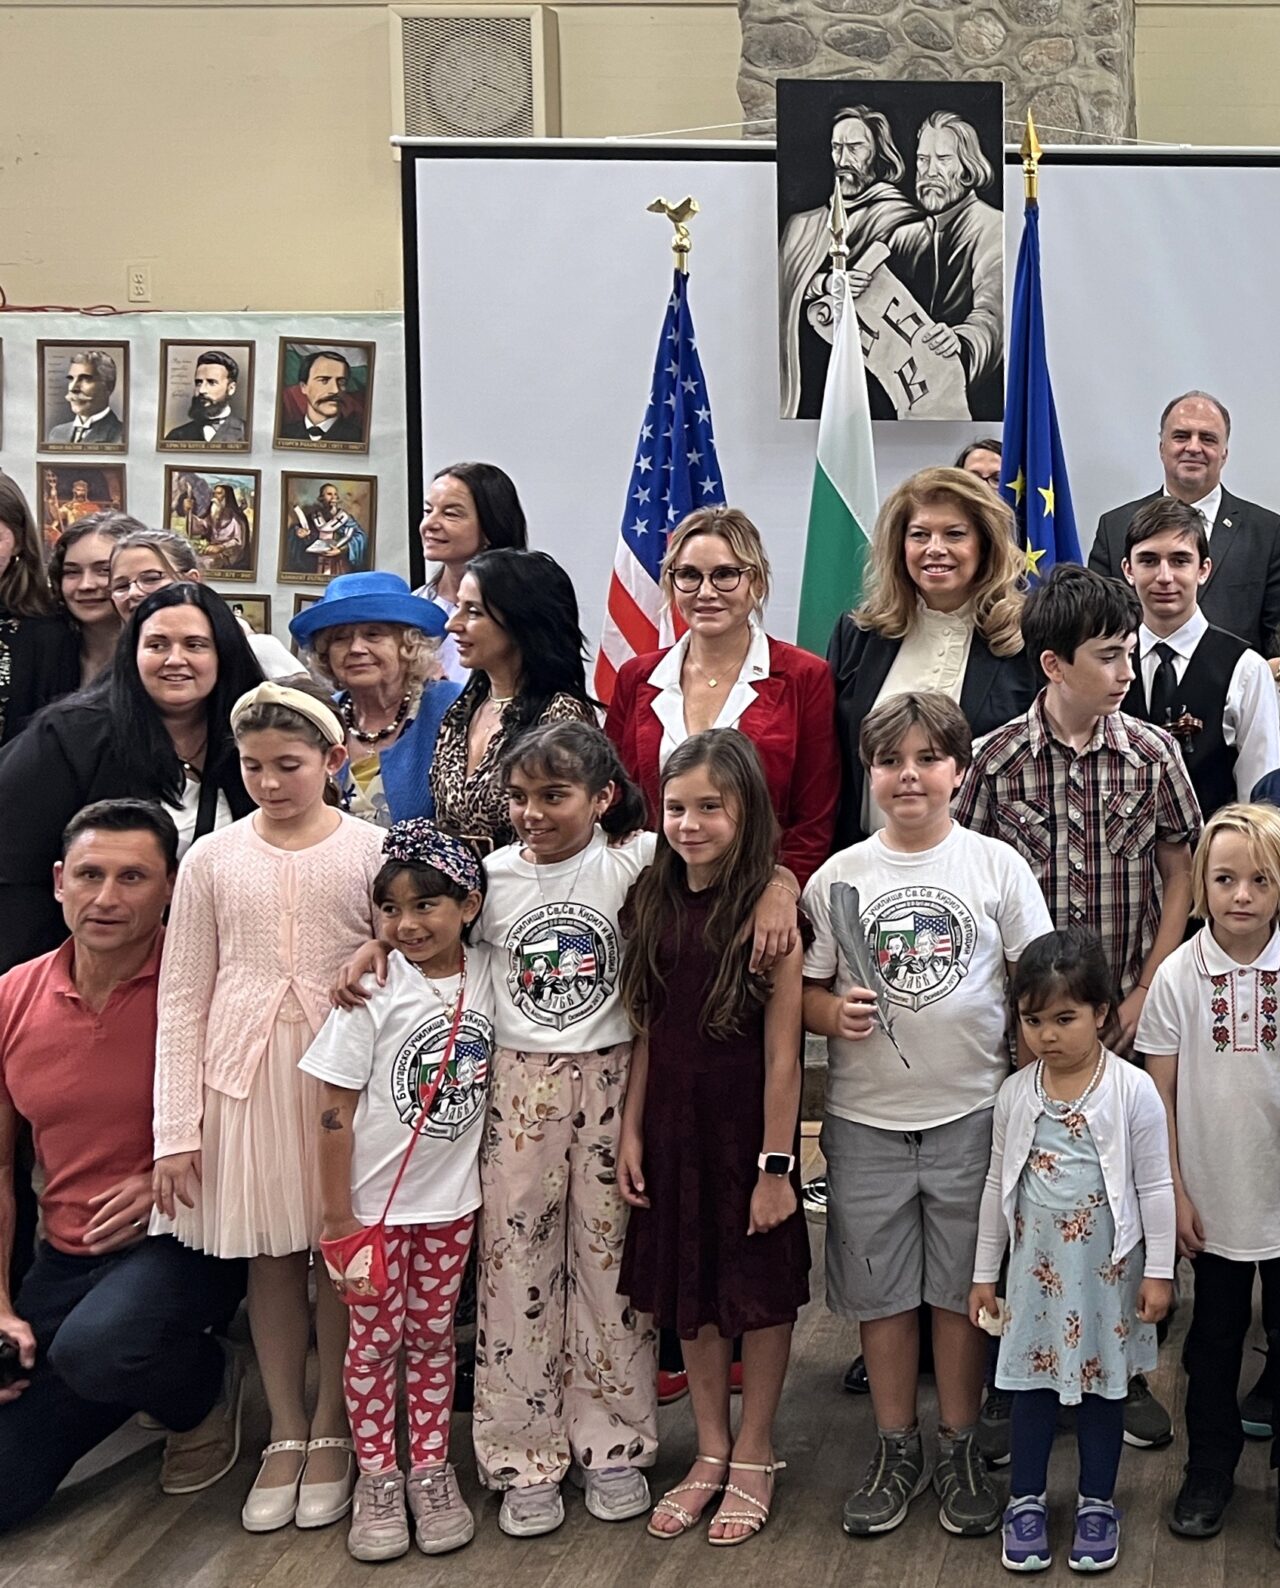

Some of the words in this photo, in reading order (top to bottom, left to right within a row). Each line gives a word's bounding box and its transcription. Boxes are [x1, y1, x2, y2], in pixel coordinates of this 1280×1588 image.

[935, 891, 961, 911] Кирил
[957, 909, 965, 917] и
[512, 911, 545, 941] училище
[578, 907, 604, 928] Кирил
[600, 926, 609, 935] и
[396, 1049, 412, 1101] Българско
[408, 1018, 445, 1049] училище
